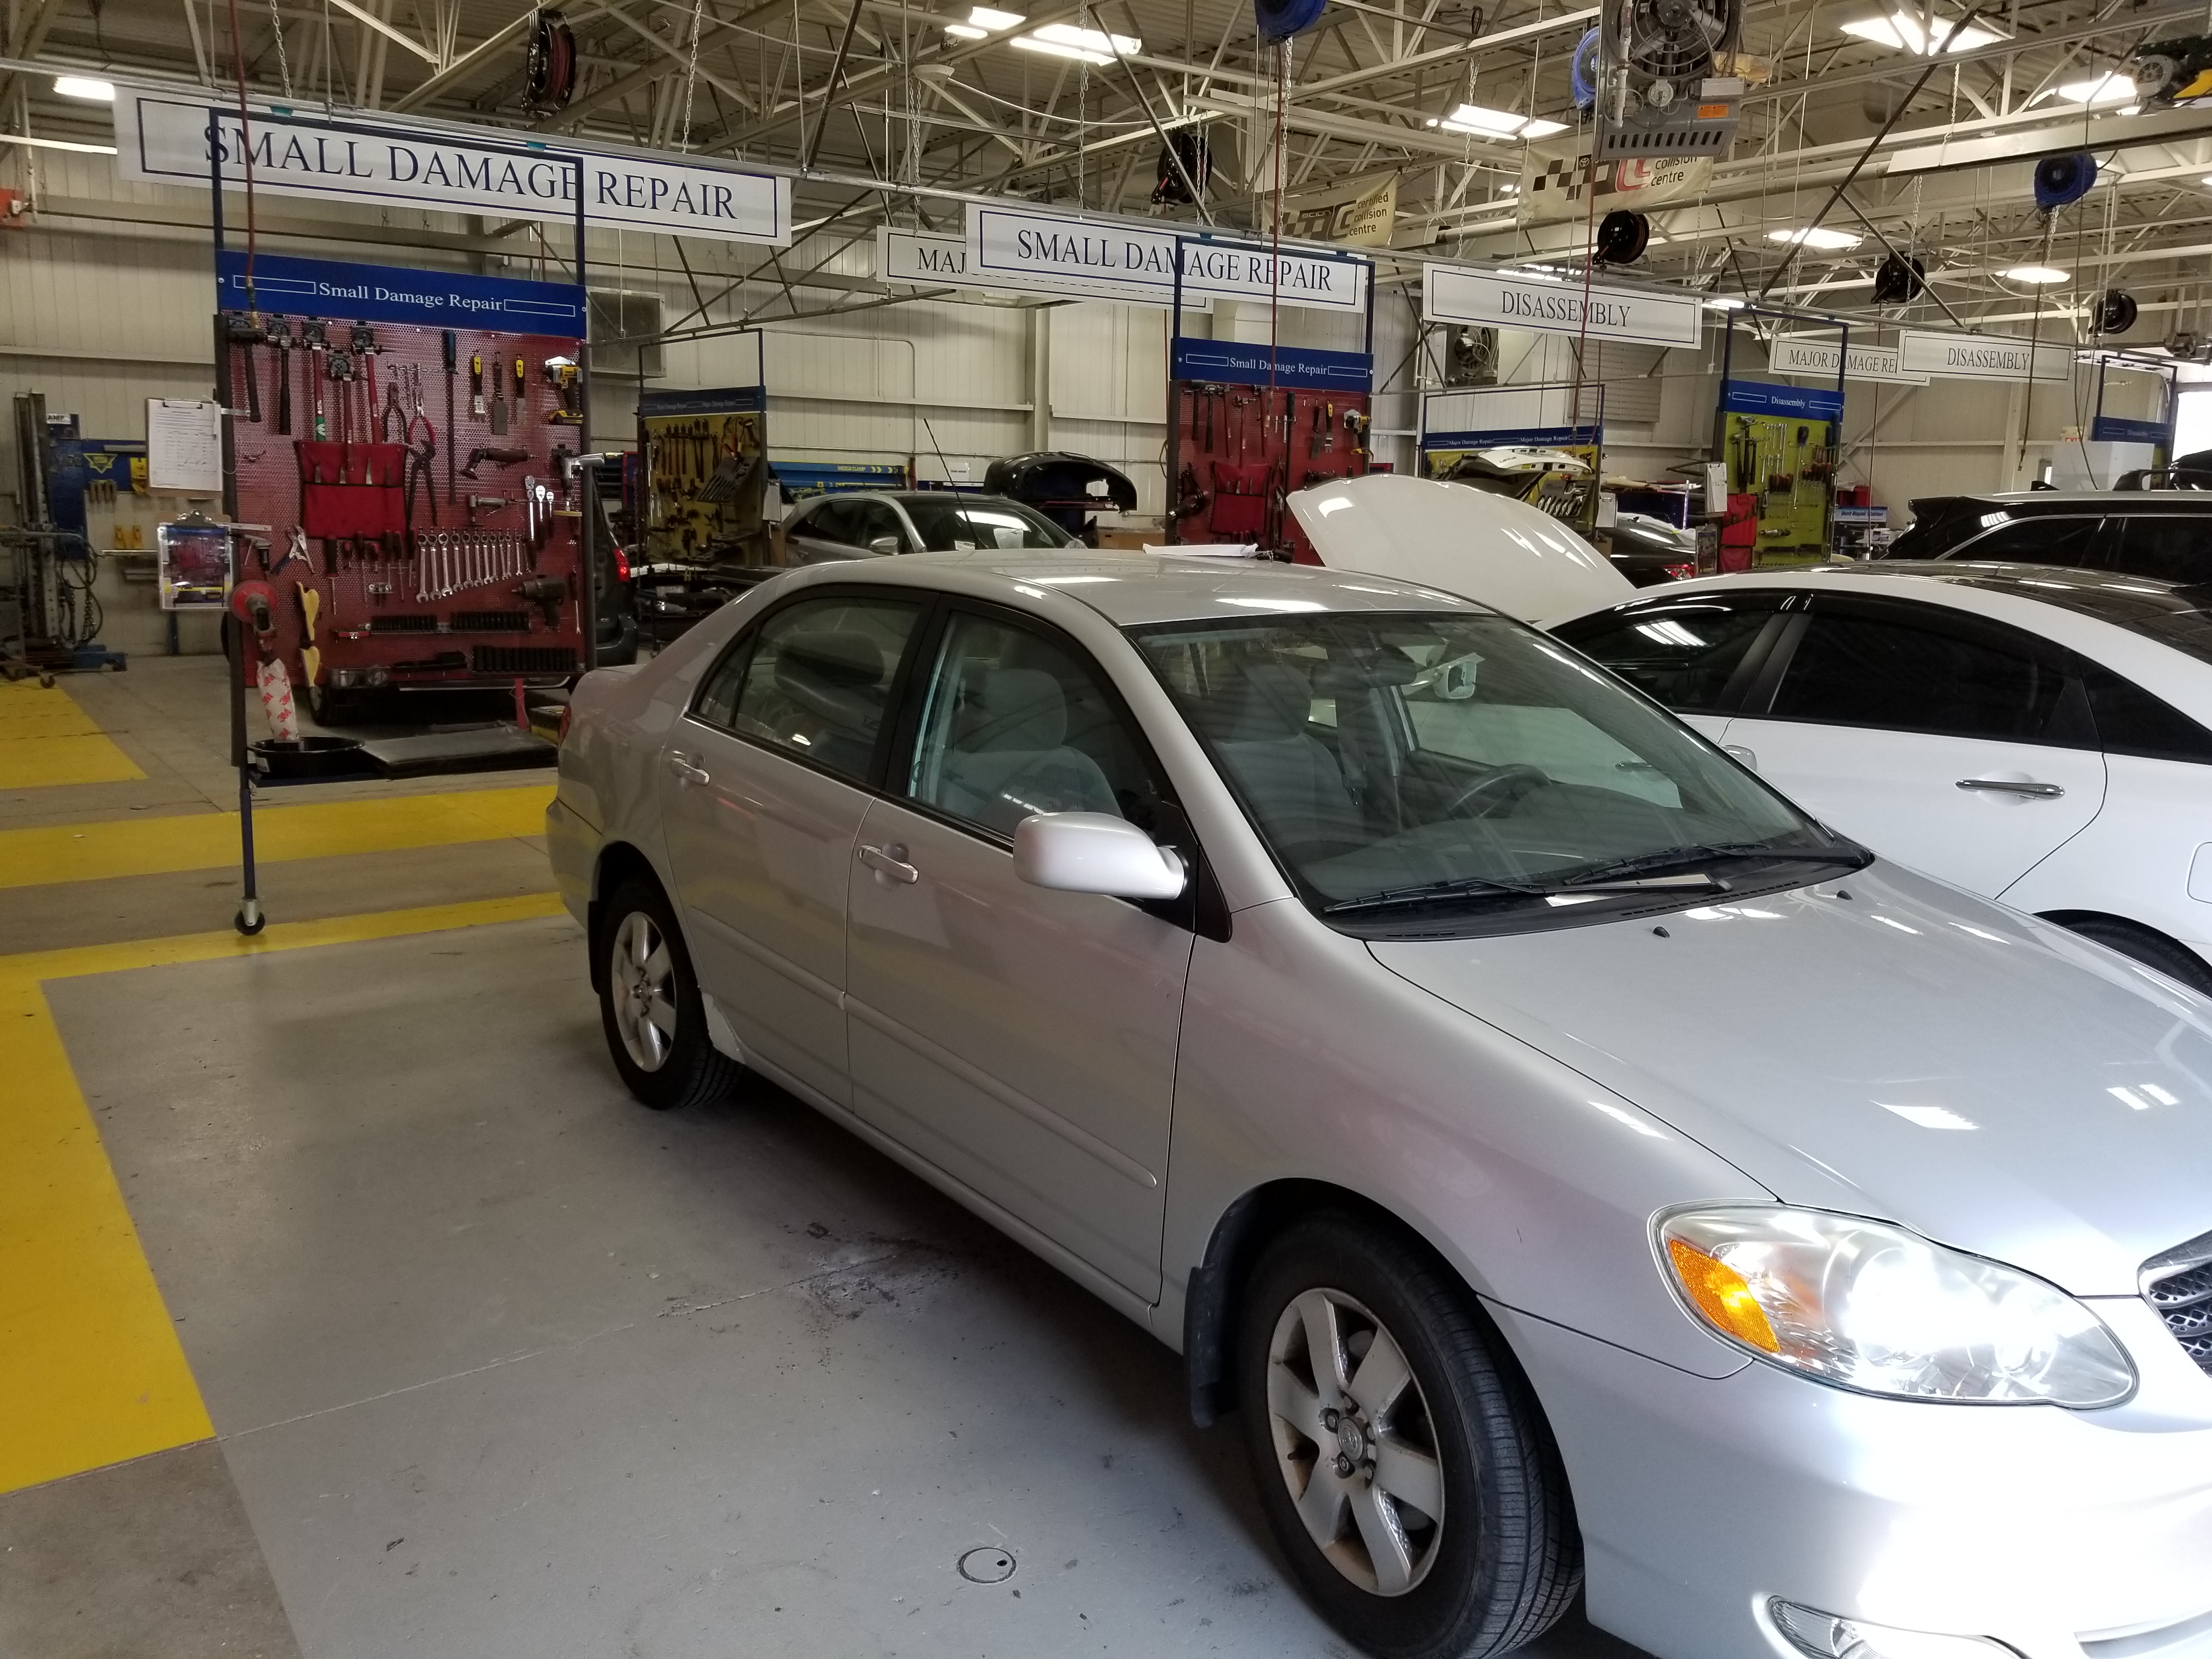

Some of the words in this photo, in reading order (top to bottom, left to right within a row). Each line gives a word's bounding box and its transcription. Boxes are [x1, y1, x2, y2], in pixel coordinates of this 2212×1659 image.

[204, 126, 374, 178] SMALL
[594, 170, 738, 219] REPAIR
[1651, 170, 1684, 187] centre
[1357, 191, 1389, 210] certified
[1354, 208, 1387, 222] collision
[1349, 223, 1376, 236] centre
[1017, 229, 1116, 268] SMALL
[1124, 241, 1240, 281] DAMAGE
[1247, 256, 1333, 291] REPAIR
[319, 282, 369, 299] Small
[374, 287, 444, 308] Damage
[448, 294, 503, 312] Repair
[1501, 290, 1631, 327] DISASSEMBLY
[1229, 357, 1256, 369] Small
[1259, 360, 1296, 373] Damage
[1298, 363, 1327, 376] Repair
[1788, 349, 1828, 368] MAJOR
[1831, 353, 1880, 372] DMAGE
[1947, 347, 2030, 370] DISASSEMBLY
[1771, 396, 1806, 409] Disassembly
